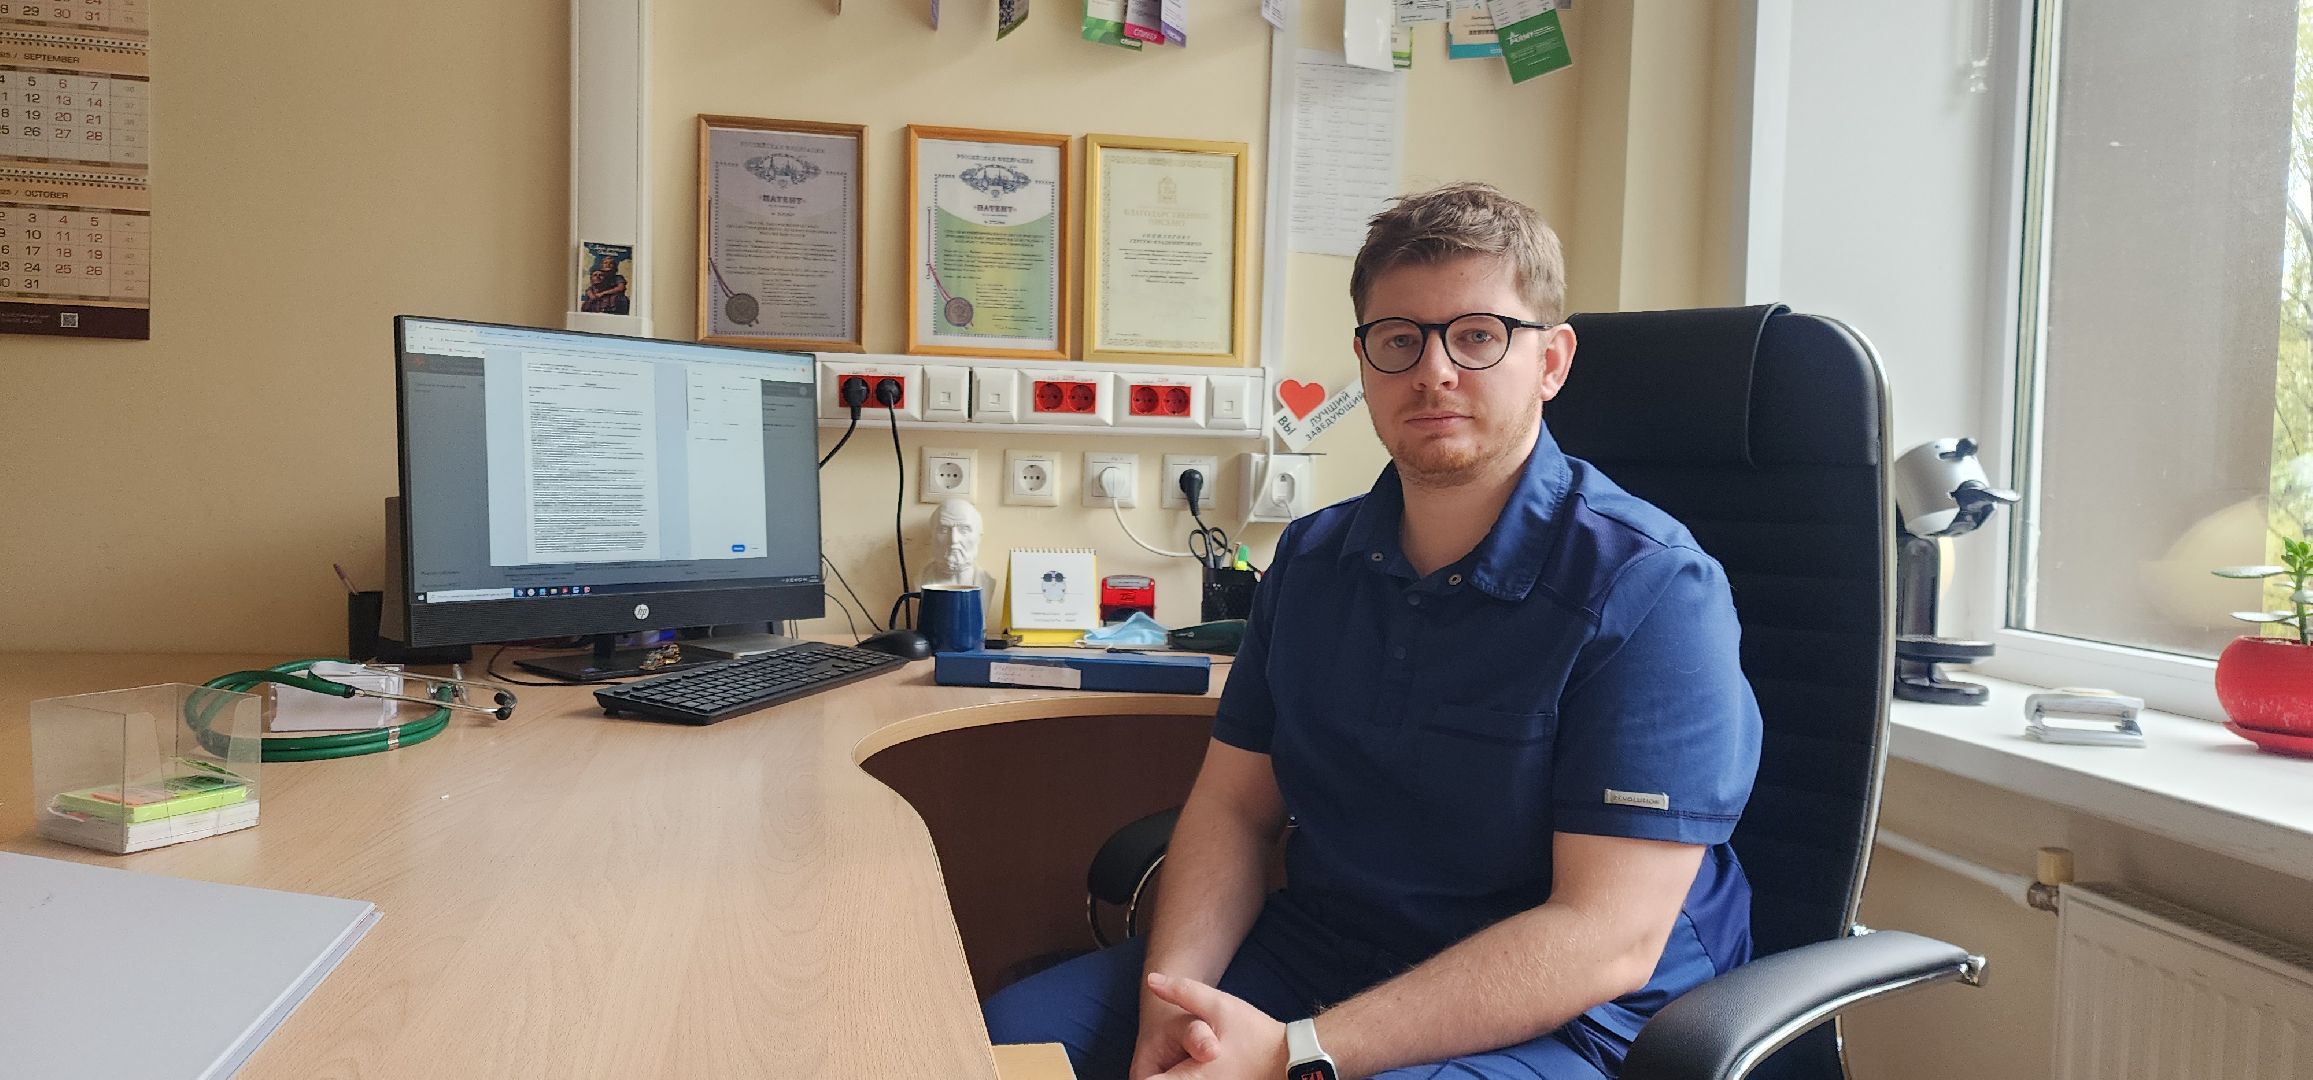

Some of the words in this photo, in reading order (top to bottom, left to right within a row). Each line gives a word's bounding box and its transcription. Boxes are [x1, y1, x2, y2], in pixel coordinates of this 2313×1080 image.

[23, 6, 39, 16] 29
[54, 8, 70, 18] 30
[85, 11, 100, 20] 31
[24, 53, 80, 63] SEPTEMBER
[28, 77, 36, 86] 5
[59, 79, 67, 88] 6
[90, 82, 98, 90] 7
[25, 93, 40, 103] 12
[56, 95, 72, 106] 13
[87, 98, 102, 108] 14
[26, 110, 41, 120] 19
[55, 112, 72, 122] 20
[86, 114, 101, 124] 21
[24, 127, 41, 136] 26
[55, 129, 72, 138] 27
[86, 131, 102, 141] 28
[25, 190, 69, 199] OCTOBER
[28, 213, 37, 223] 3
[59, 215, 68, 224] 4
[90, 217, 99, 227] 5
[26, 230, 42, 240] 10
[56, 231, 71, 241] 11
[87, 233, 102, 243] 12
[25, 246, 41, 256] 17
[56, 248, 72, 258] 18
[87, 250, 102, 259] 19
[24, 263, 41, 273] 24
[55, 264, 72, 274] 25
[86, 266, 102, 276] 26
[24, 279, 39, 289] 31
[1305, 391, 1364, 441] ЗАВЕДУЮЩИЙ
[1309, 391, 1351, 427] ЛУЧШИЙ
[1278, 416, 1296, 435] ВЫ
[636, 605, 648, 619] hp
